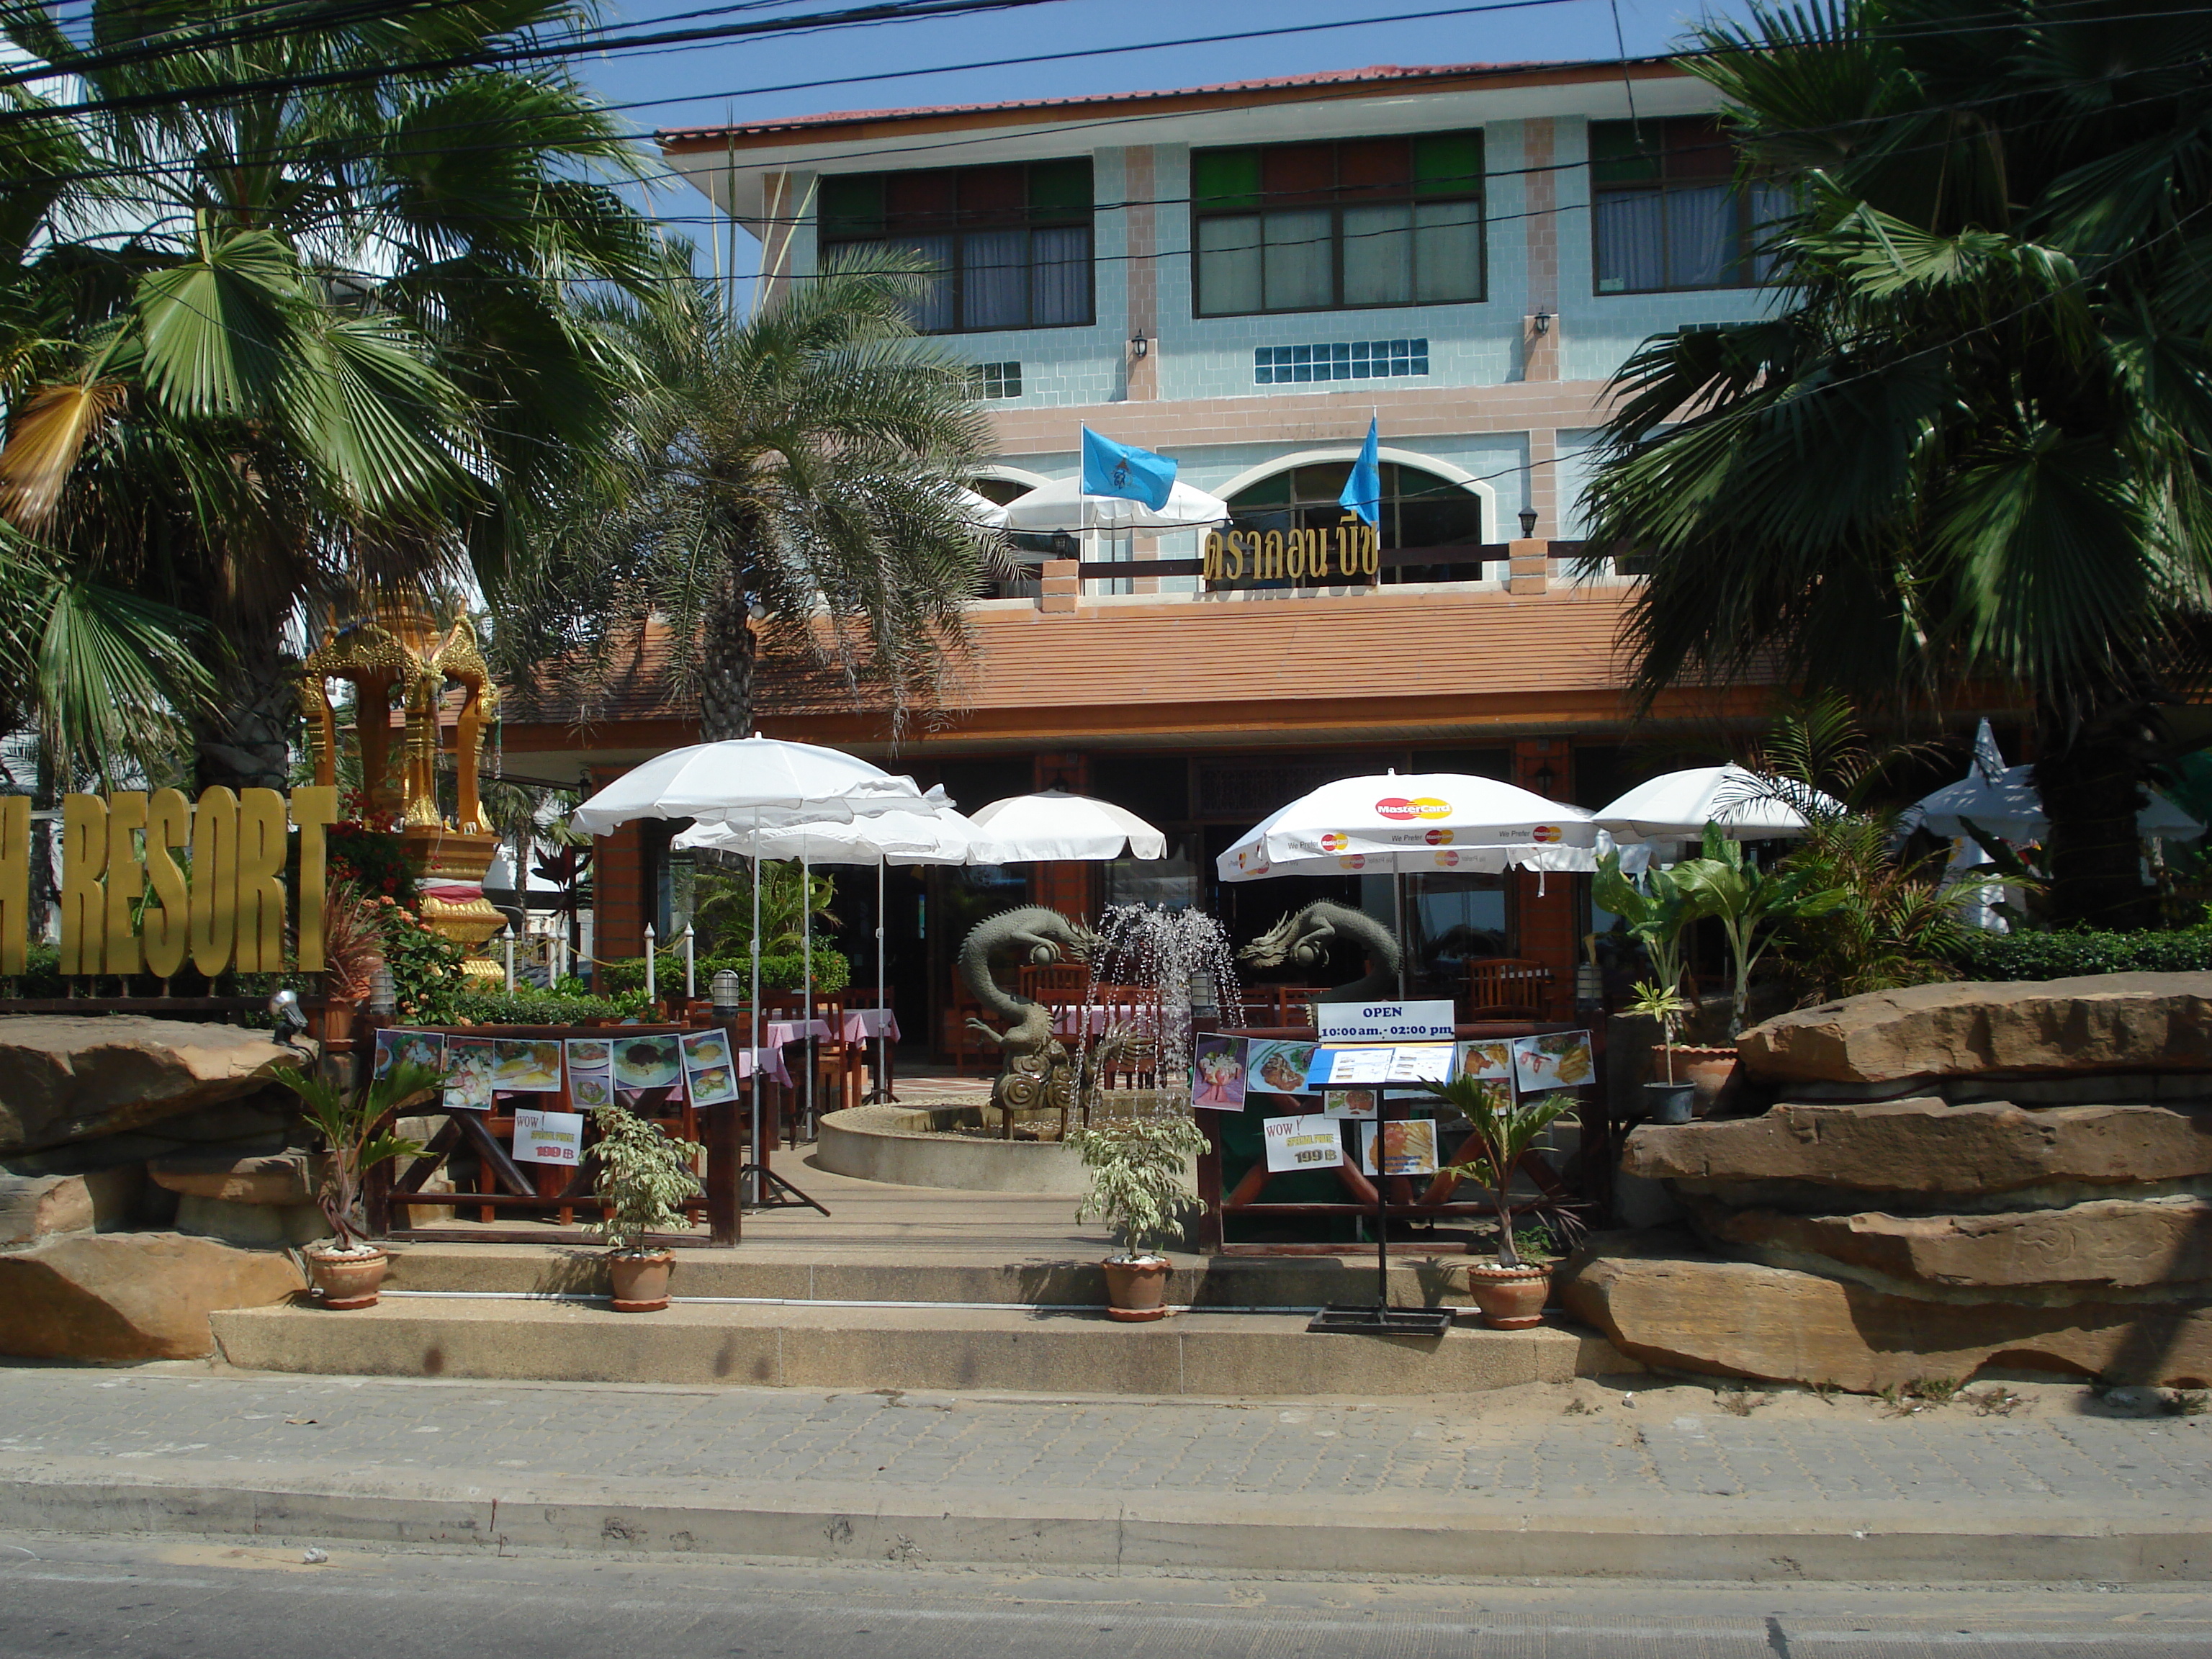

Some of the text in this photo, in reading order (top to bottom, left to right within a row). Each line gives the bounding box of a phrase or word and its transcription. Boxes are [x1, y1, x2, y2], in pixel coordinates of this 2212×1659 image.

[1377, 804, 1450, 814] MasterCard
[60, 785, 338, 978] RESORT
[1363, 1007, 1403, 1017] OPEN
[1390, 1025, 1426, 1035] 02:00
[516, 1115, 539, 1128] WOW
[1266, 1123, 1292, 1138] WOW
[535, 1146, 561, 1157] 199
[1295, 1148, 1323, 1164] 199
